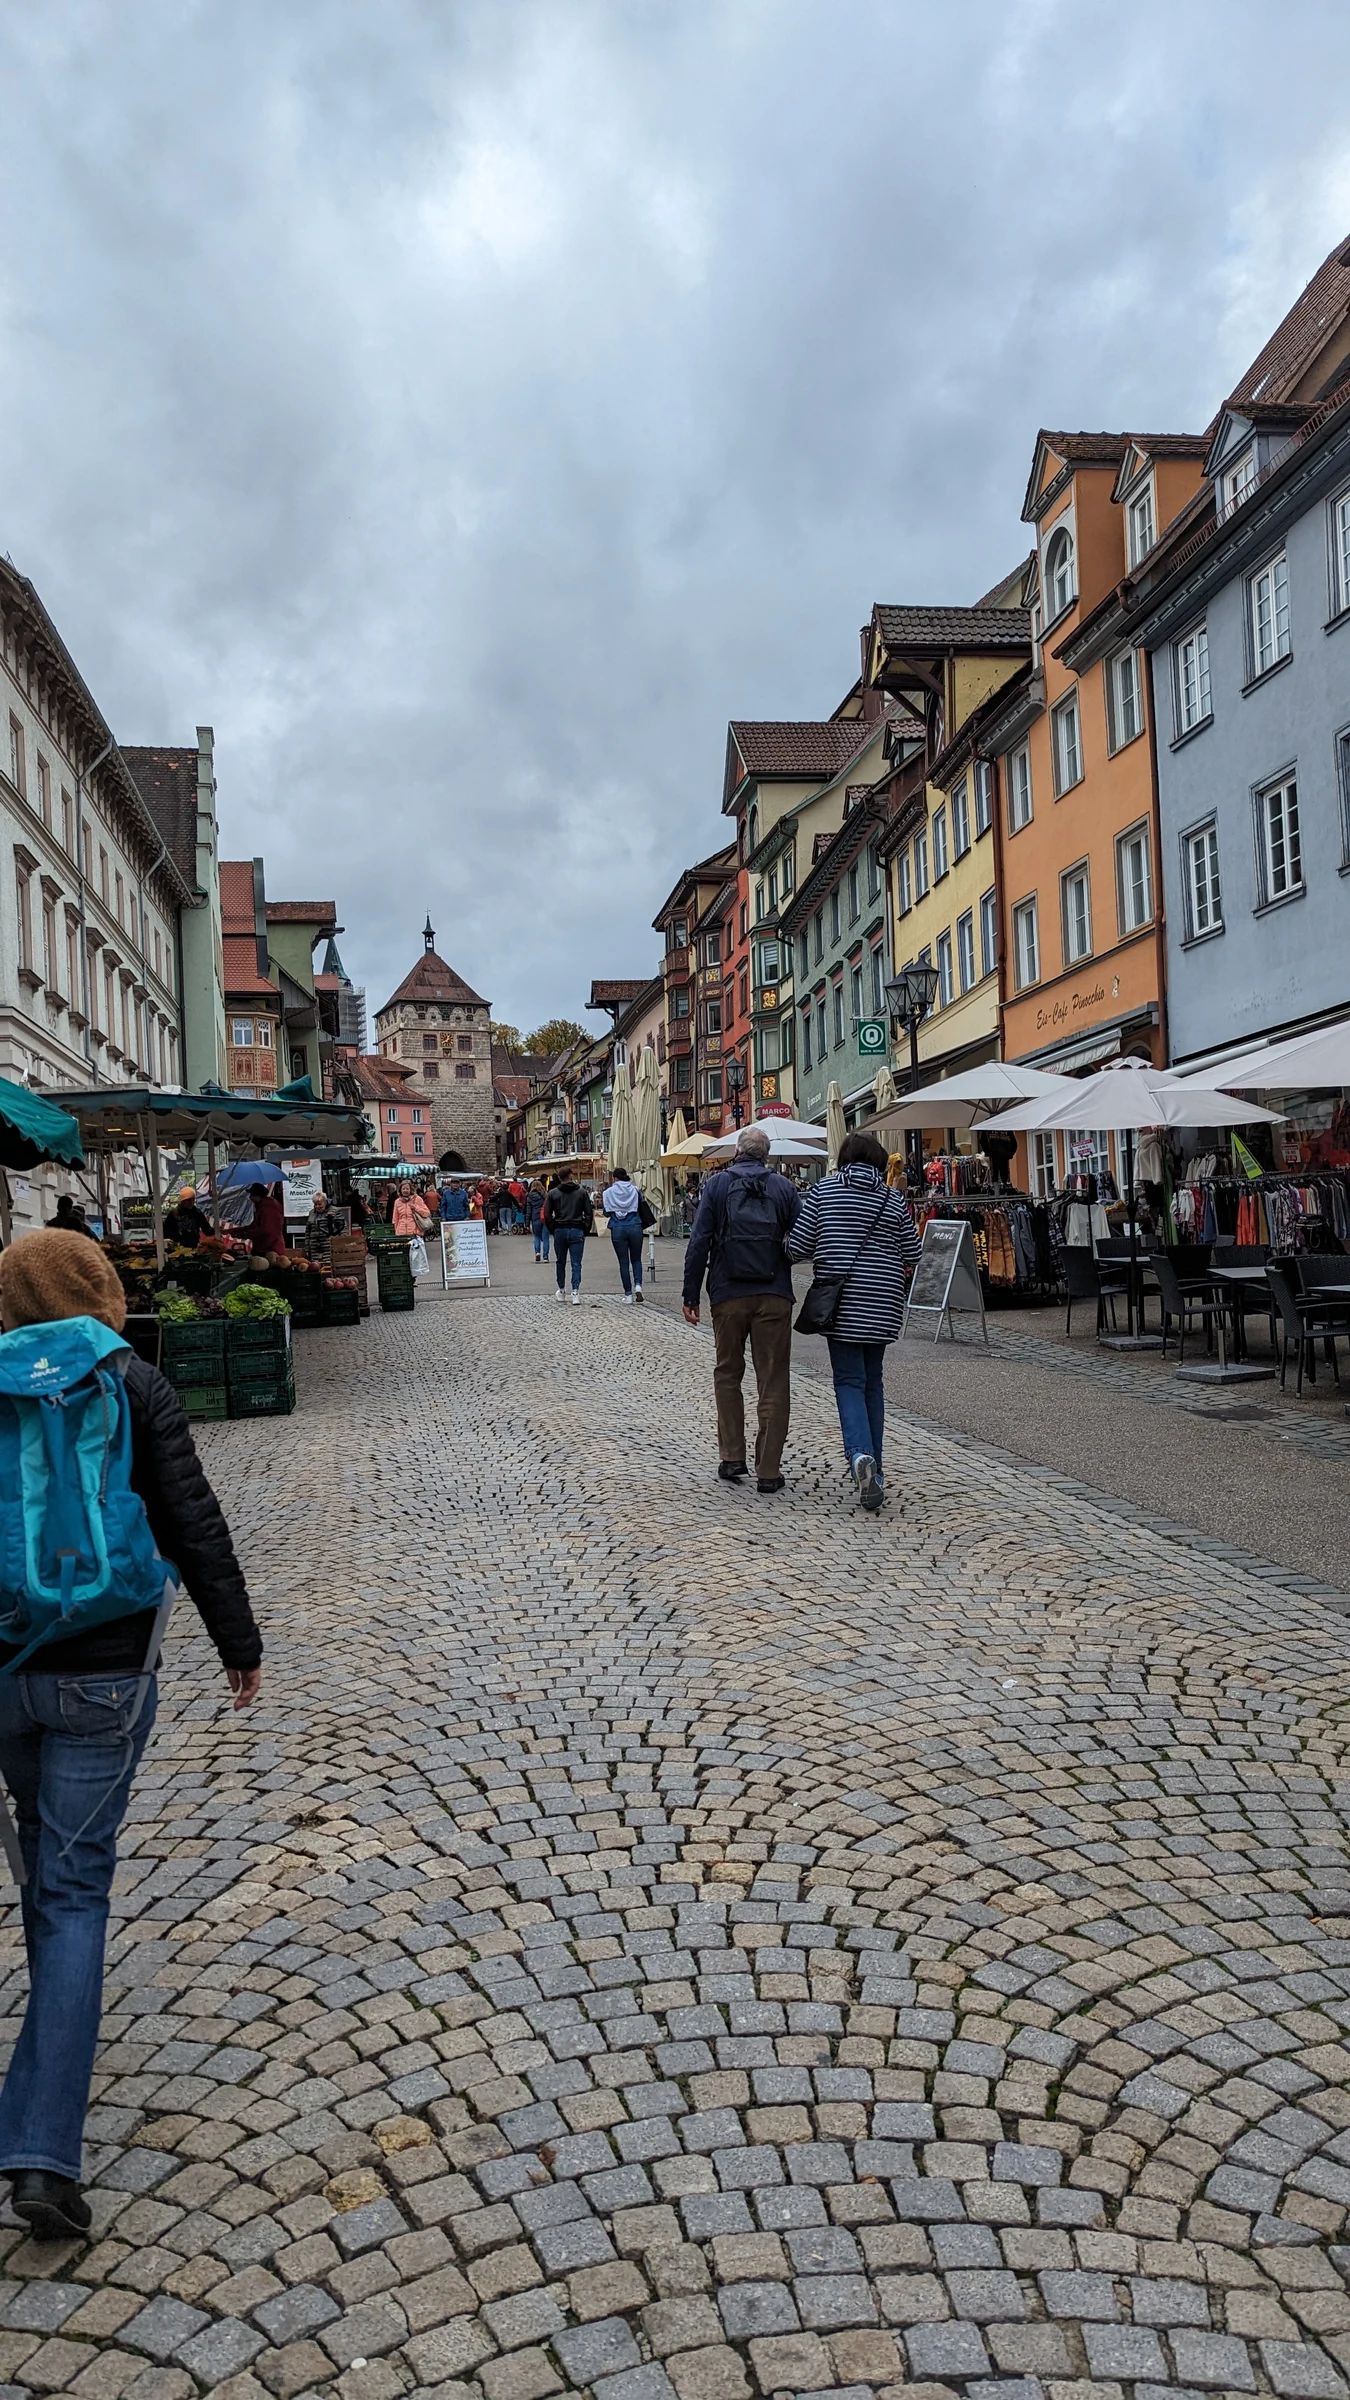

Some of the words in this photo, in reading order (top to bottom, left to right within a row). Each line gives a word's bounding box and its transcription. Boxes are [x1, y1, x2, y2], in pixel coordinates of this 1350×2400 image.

[1036, 1001, 1068, 1030] Eis-Cafe
[1072, 984, 1105, 1015] Pinocchio
[762, 1107, 790, 1115] MARCO
